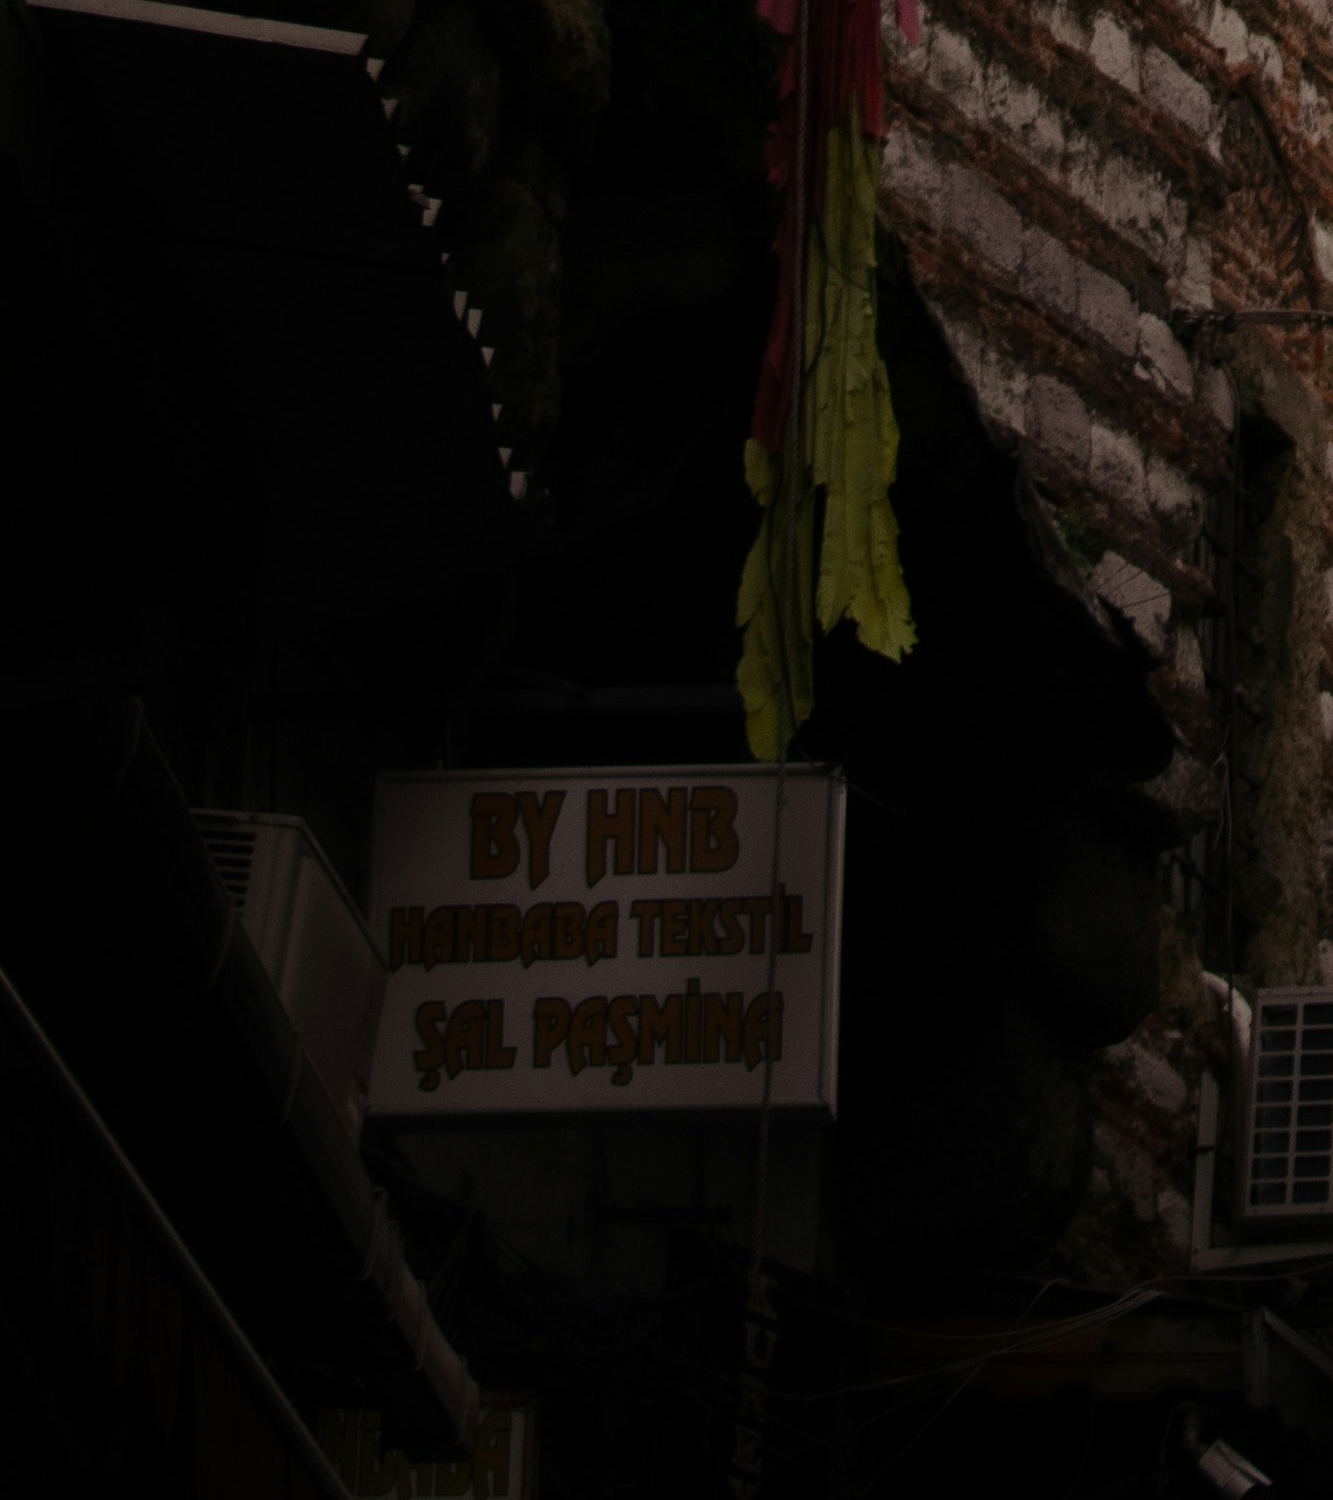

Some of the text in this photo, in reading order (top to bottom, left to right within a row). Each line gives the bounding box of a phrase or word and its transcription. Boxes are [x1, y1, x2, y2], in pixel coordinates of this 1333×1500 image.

[470, 786, 740, 890] BY HNB
[390, 883, 814, 974] HANBABA TEKSTİL
[414, 978, 785, 1092] ŞAL PAŞMİNA
